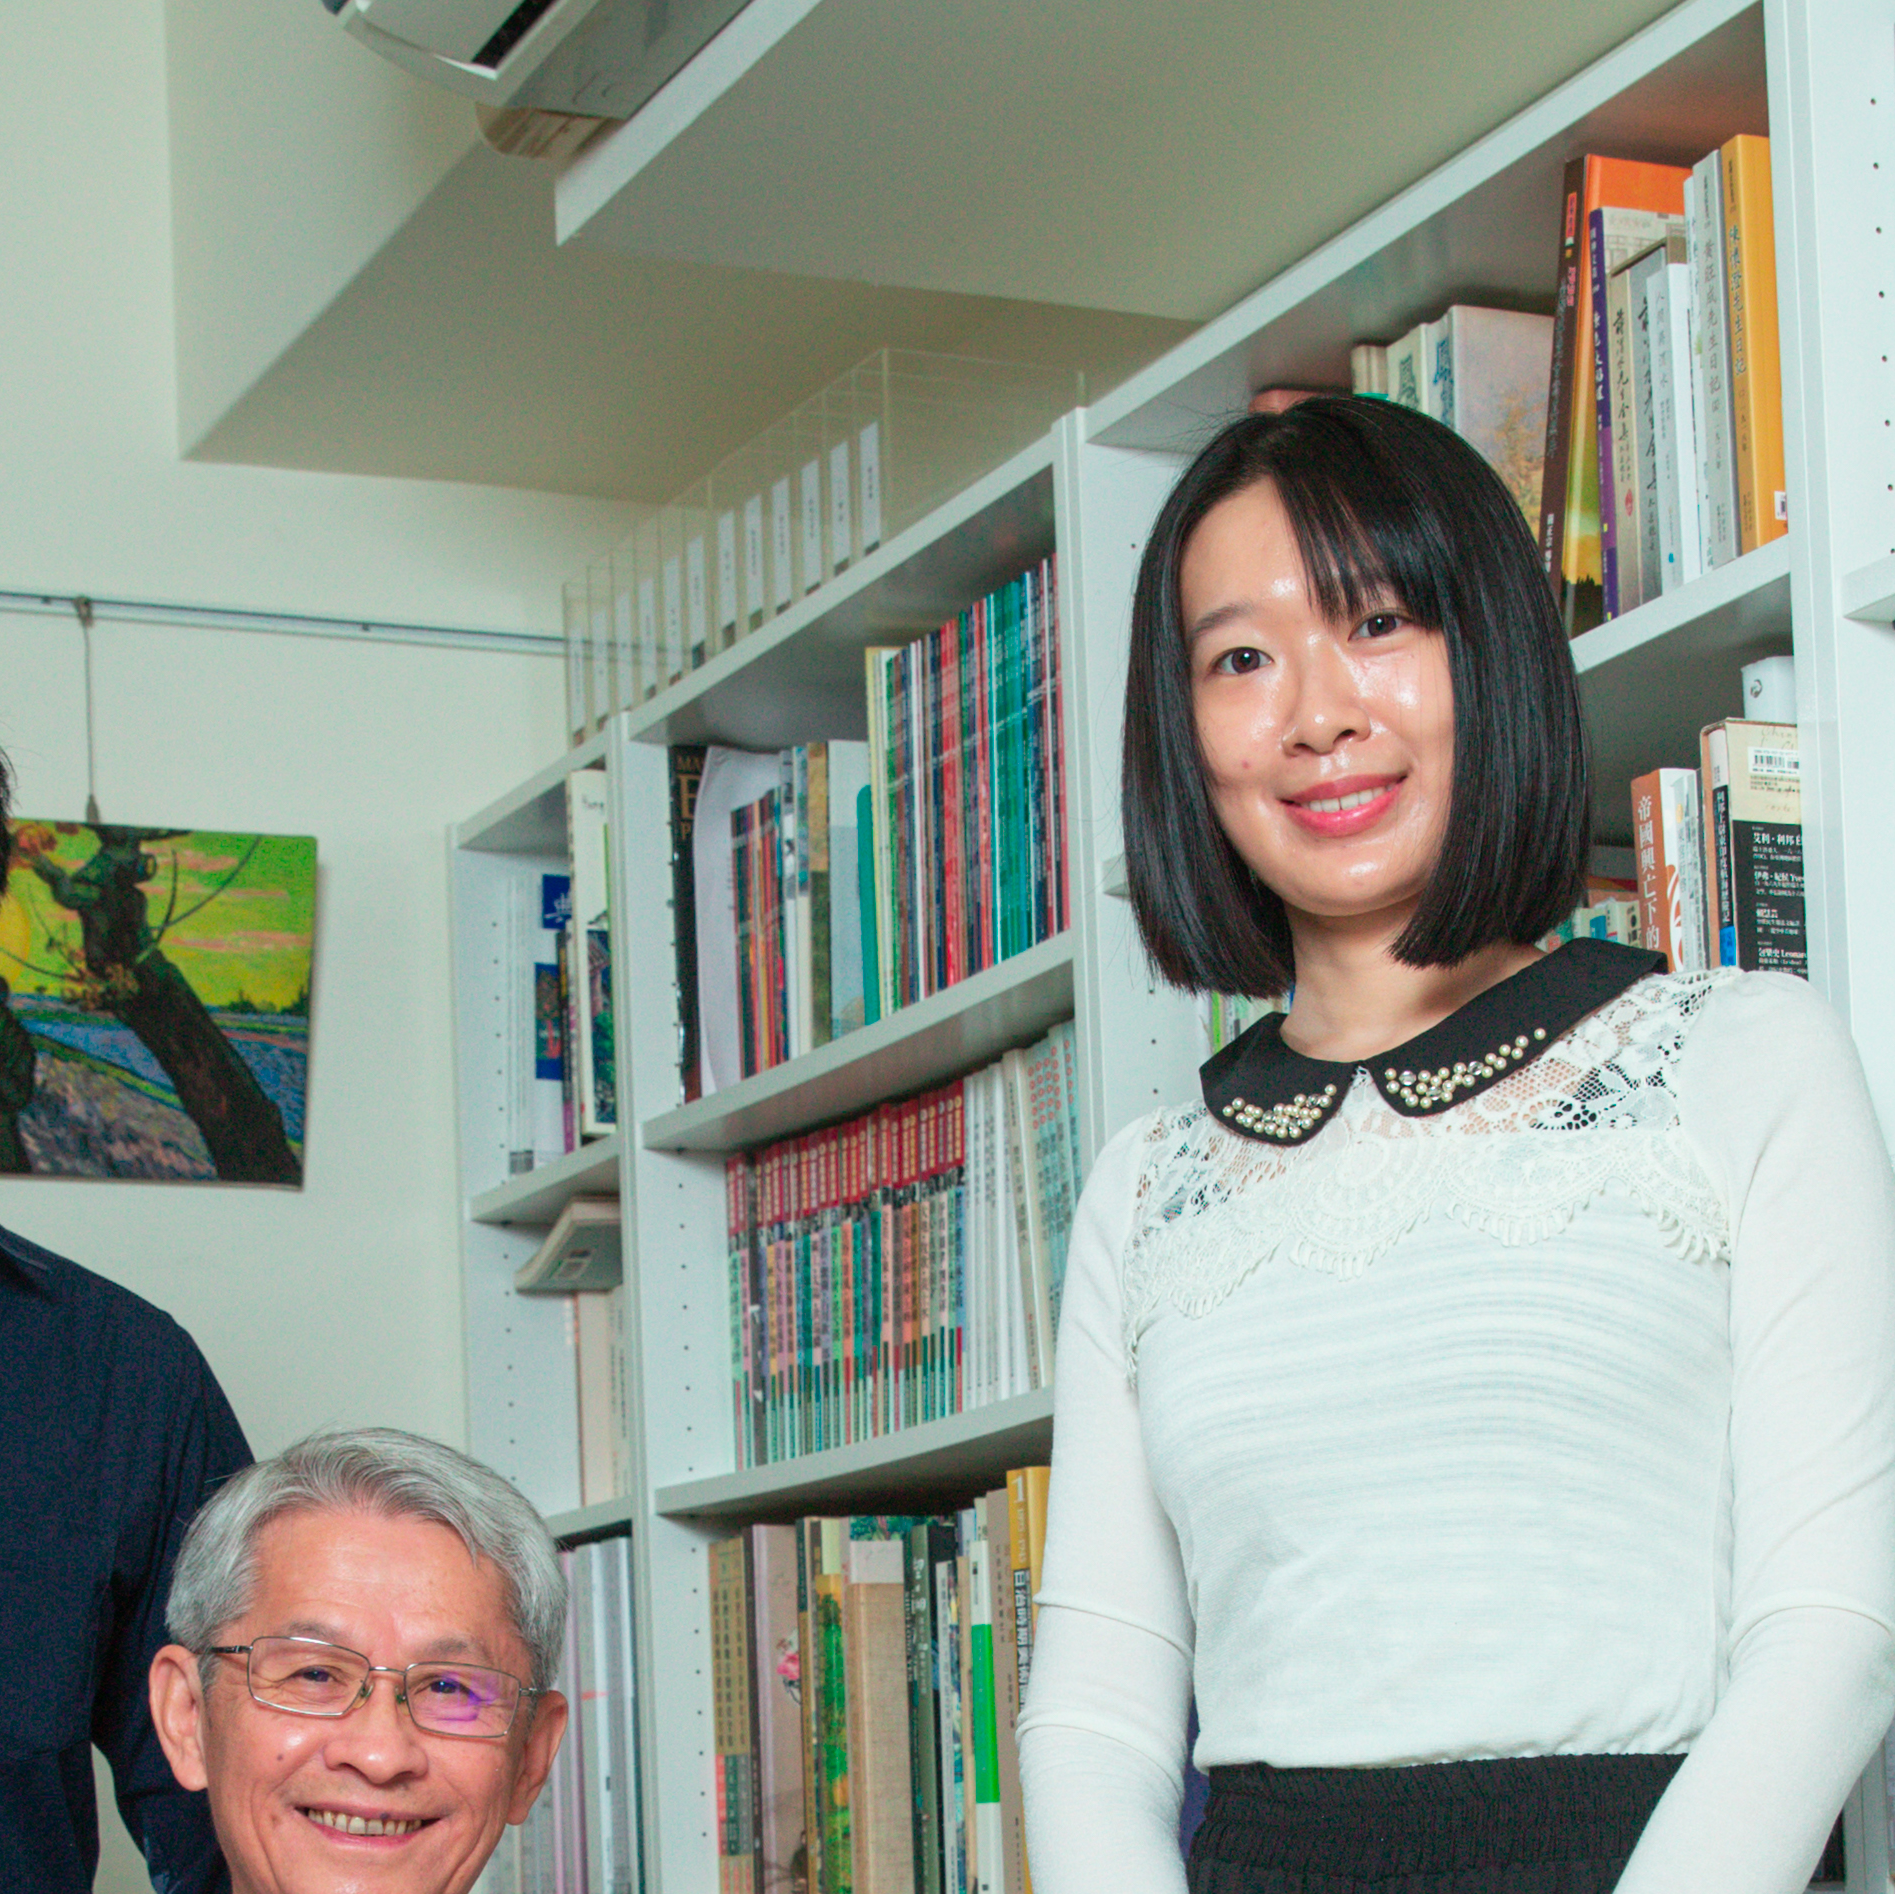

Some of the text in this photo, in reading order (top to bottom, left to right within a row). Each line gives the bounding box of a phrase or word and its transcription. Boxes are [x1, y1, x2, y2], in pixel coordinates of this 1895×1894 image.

[1637, 794, 1660, 950] 帝國興亡下的
